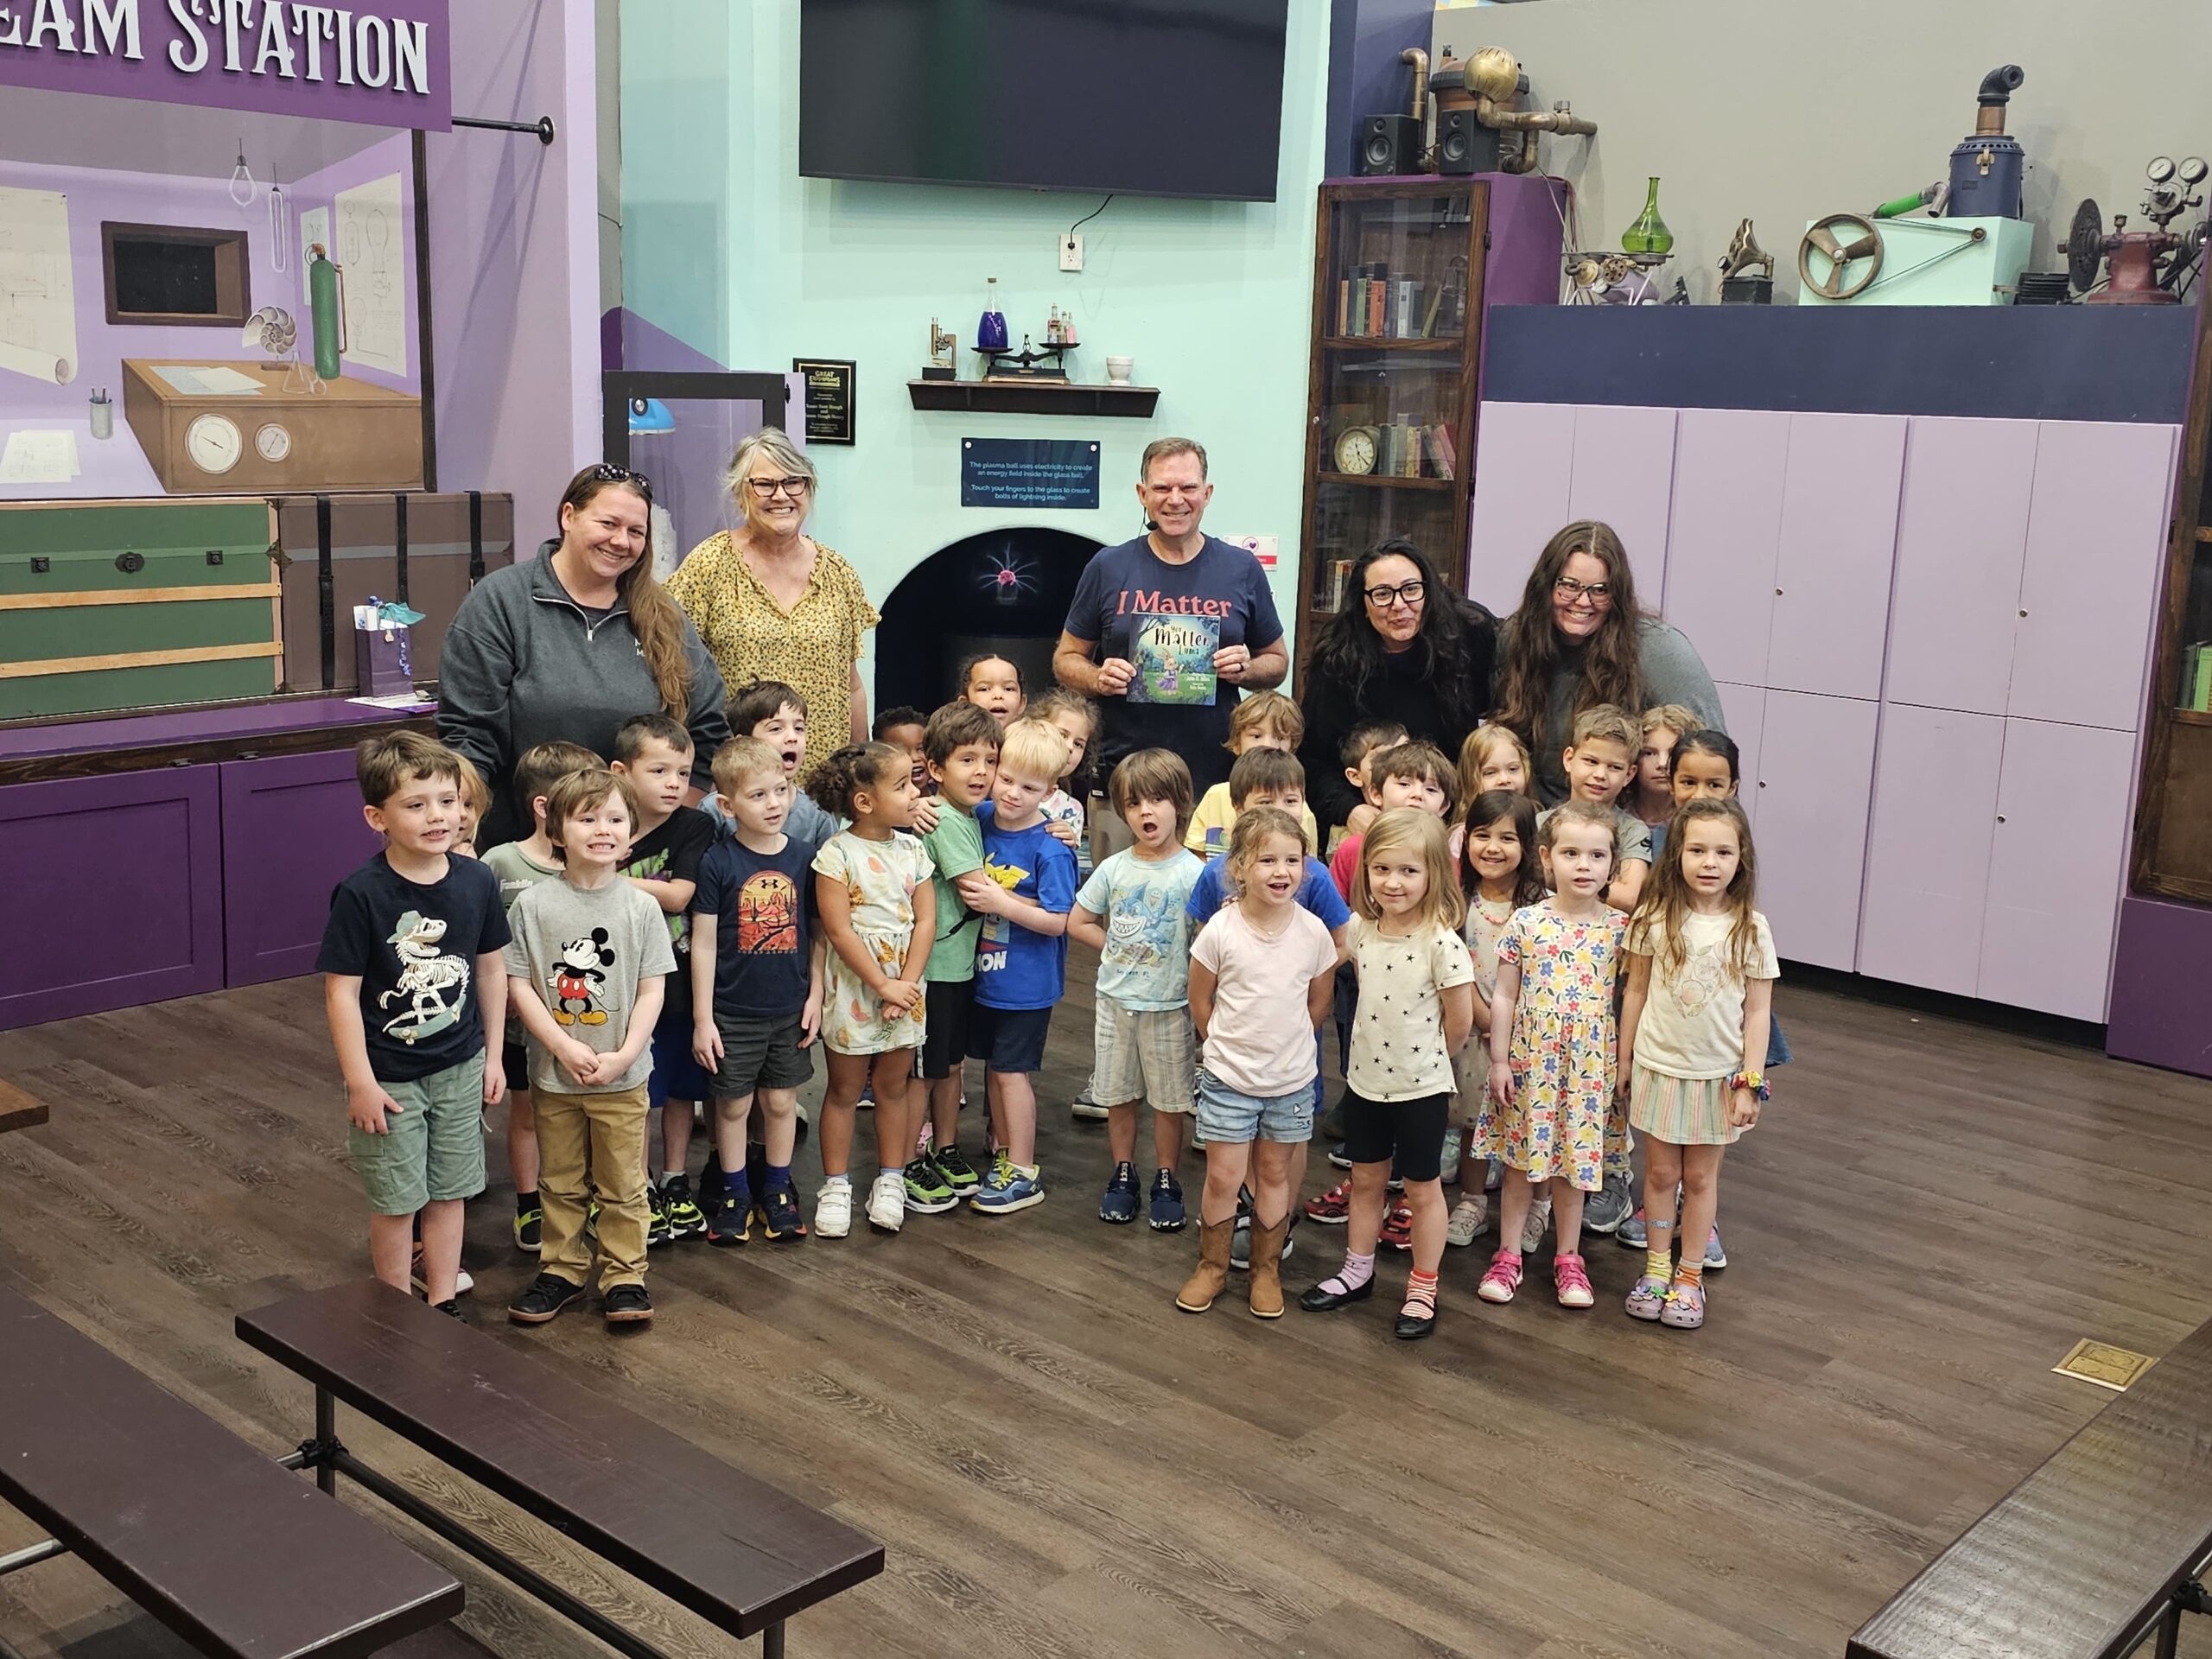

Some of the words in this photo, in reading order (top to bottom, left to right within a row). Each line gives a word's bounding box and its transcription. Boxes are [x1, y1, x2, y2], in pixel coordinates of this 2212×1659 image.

[168, 0, 430, 94] STATION
[1116, 590, 1129, 615] I
[1131, 589, 1232, 618] Matter
